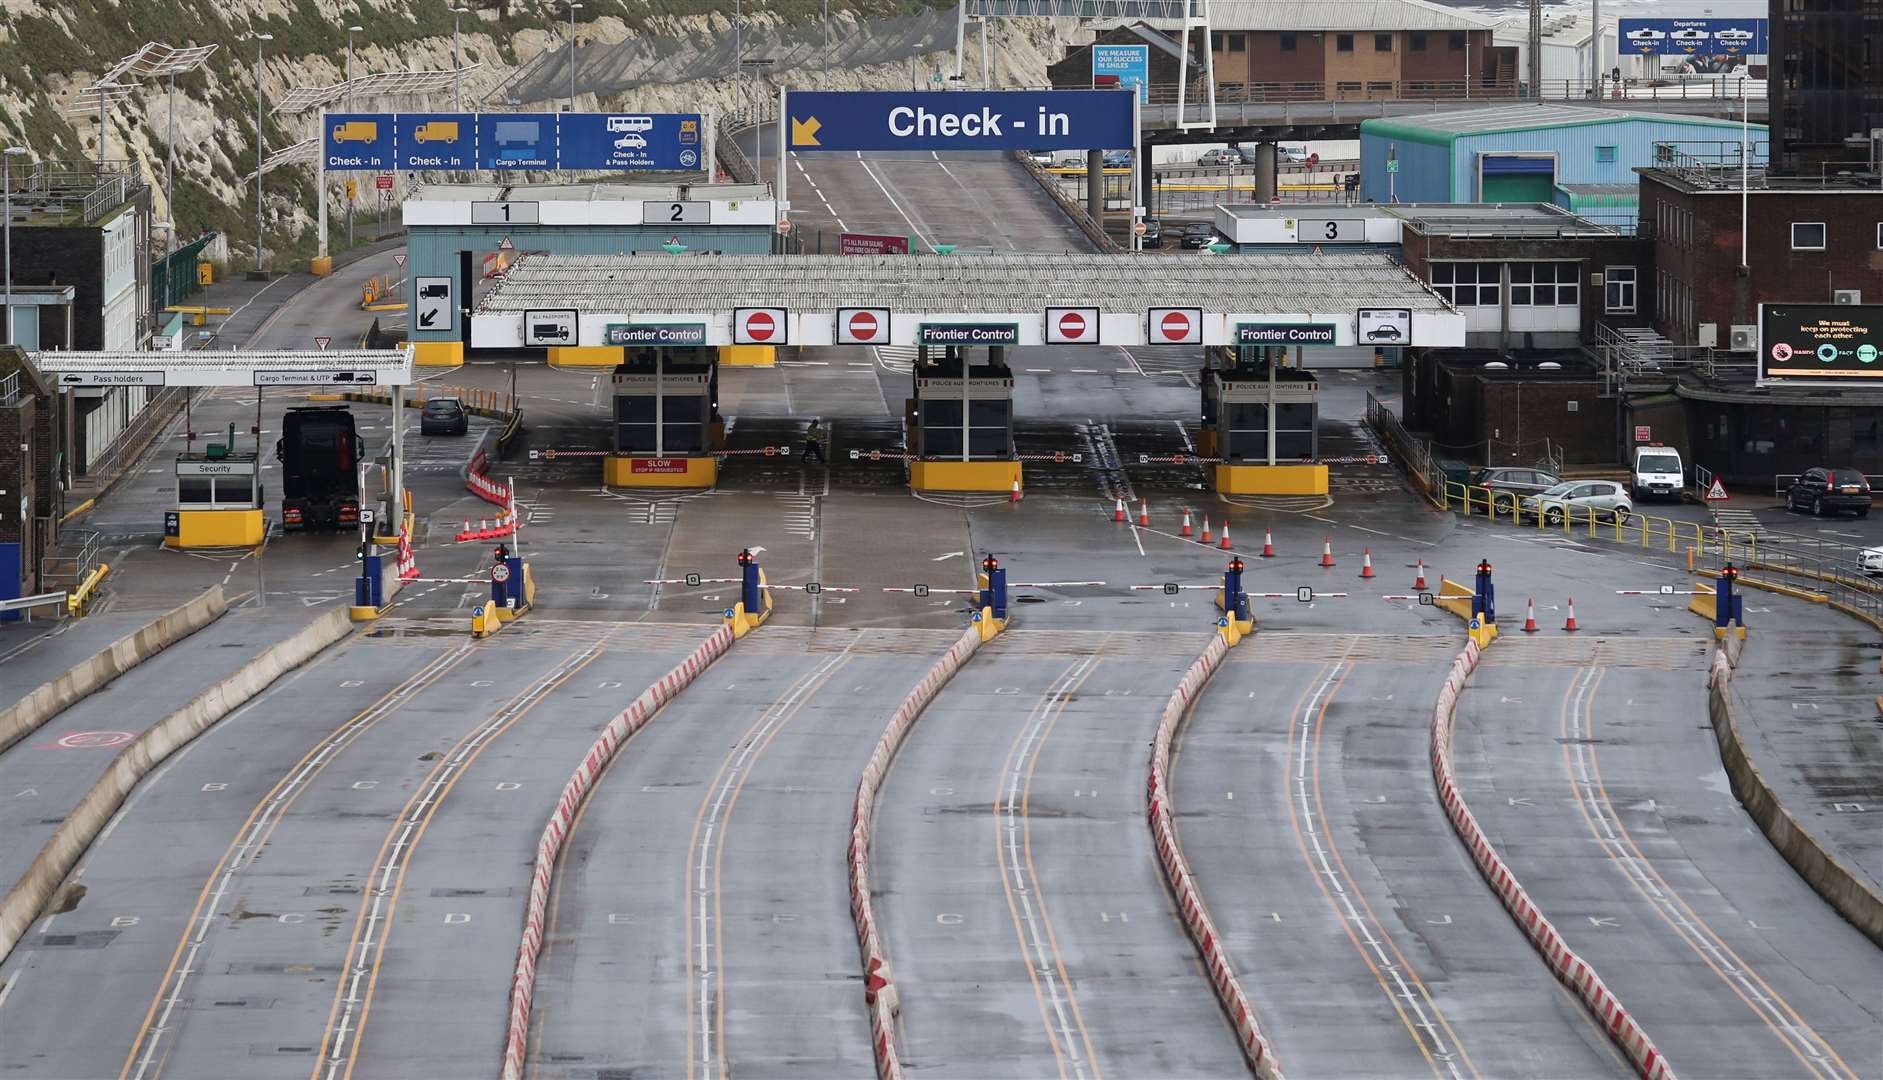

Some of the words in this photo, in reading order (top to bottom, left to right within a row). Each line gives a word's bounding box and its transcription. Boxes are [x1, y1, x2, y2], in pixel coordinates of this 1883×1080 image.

[1673, 20, 1706, 28] Departures
[1632, 39, 1660, 47] Check-in
[1675, 39, 1703, 47] Check-in
[1720, 39, 1747, 47] Check-in
[888, 106, 1002, 137] Check
[1038, 106, 1069, 136] in
[329, 156, 361, 166] Check
[371, 156, 381, 166] In
[409, 156, 441, 166] Check
[451, 156, 461, 166] In
[495, 158, 517, 168] Cargo
[517, 158, 547, 166] Terminal
[500, 204, 510, 222] 1
[670, 204, 683, 222] 2
[1325, 221, 1338, 240] 3
[611, 328, 658, 341] Frontier
[658, 328, 702, 341] Control
[923, 328, 970, 341] Frontier
[971, 328, 1015, 341] Control
[1241, 328, 1288, 341] Frontier
[1288, 328, 1332, 341] Control
[1800, 325, 1819, 333] keep
[1830, 326, 1868, 334] protecting
[93, 375, 112, 383] Pass
[113, 375, 143, 383] holders
[260, 375, 280, 383] Cargo
[199, 465, 231, 473] Security
[200, 782, 228, 792] B
[351, 780, 380, 790] C
[495, 782, 522, 791] D
[109, 916, 141, 928] B
[278, 912, 305, 924] C
[444, 912, 472, 924] D
[608, 912, 635, 924] E
